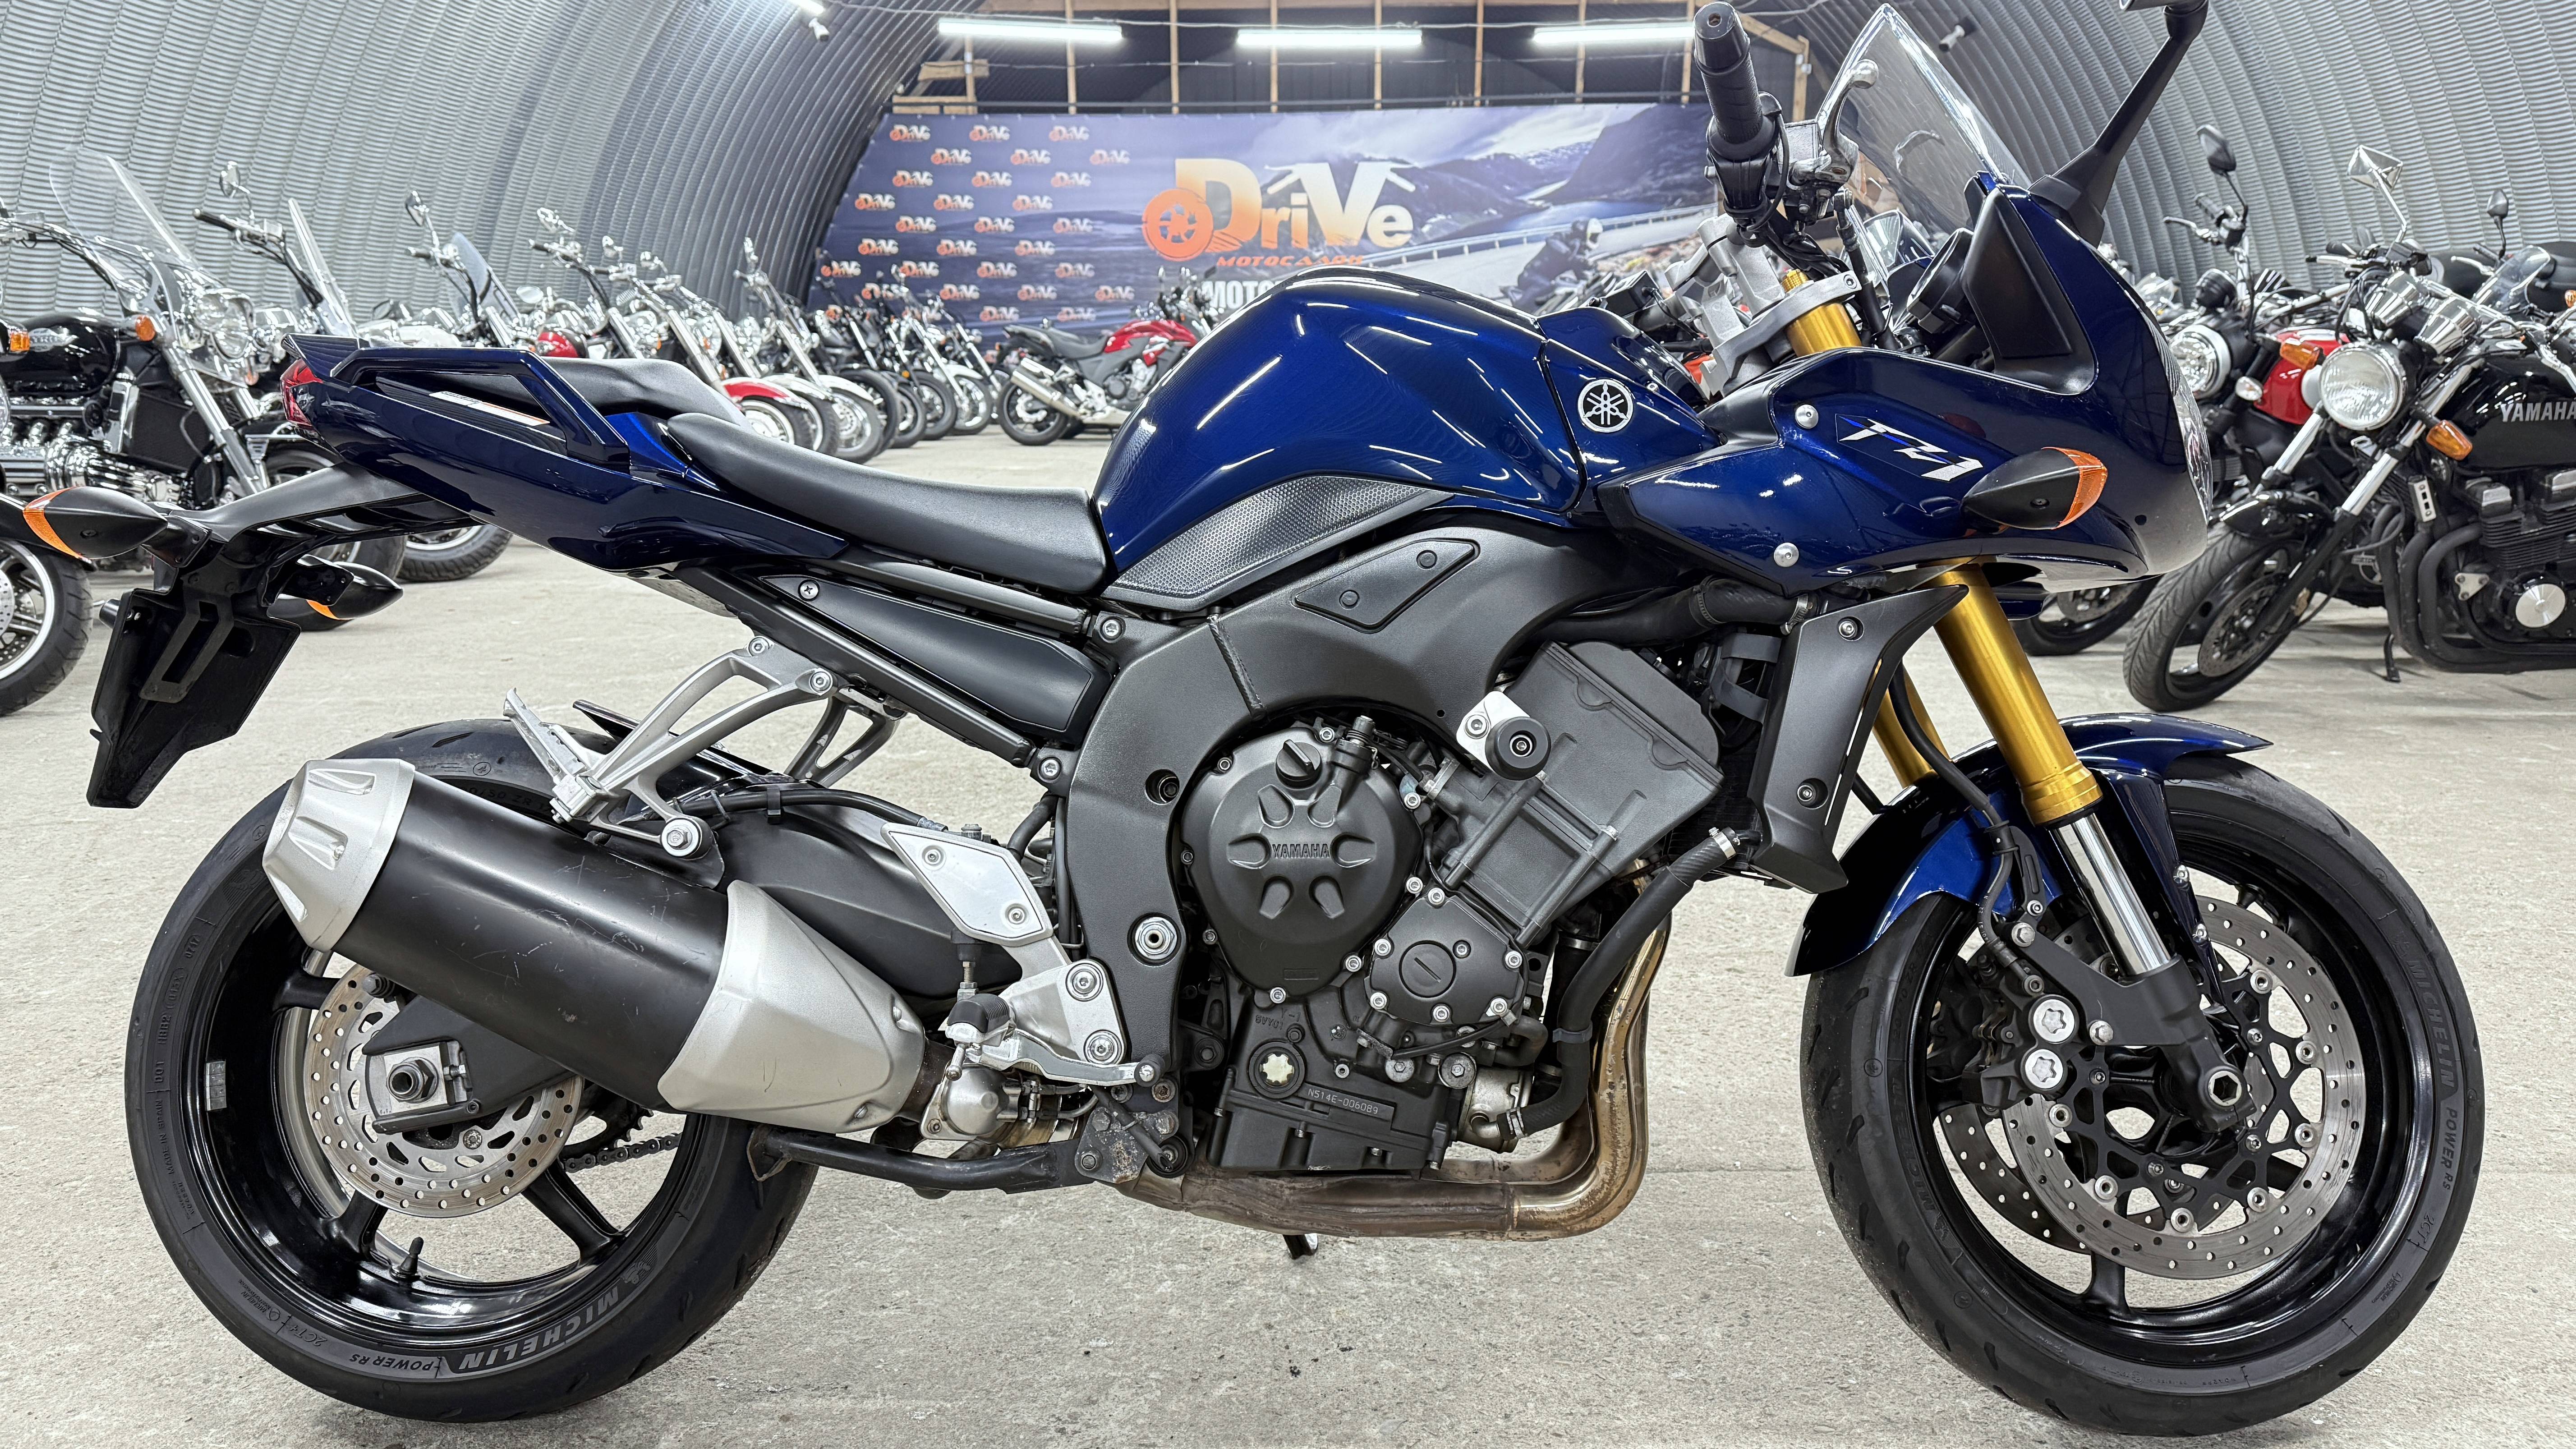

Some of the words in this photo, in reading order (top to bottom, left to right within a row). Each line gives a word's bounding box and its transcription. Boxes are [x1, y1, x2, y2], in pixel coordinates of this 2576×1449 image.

[2500, 401, 2576, 422] YAMAHA
[1272, 844, 1330, 859] YAMAHA
[2406, 961, 2455, 1087] MICHELIN
[1308, 1088, 1378, 1114] N514E-006089
[2441, 1107, 2457, 1169] POWER
[2443, 1173, 2453, 1191] RS
[459, 1286, 619, 1370] MICHELIN
[349, 1354, 370, 1365] RS
[372, 1356, 434, 1371] POWER
